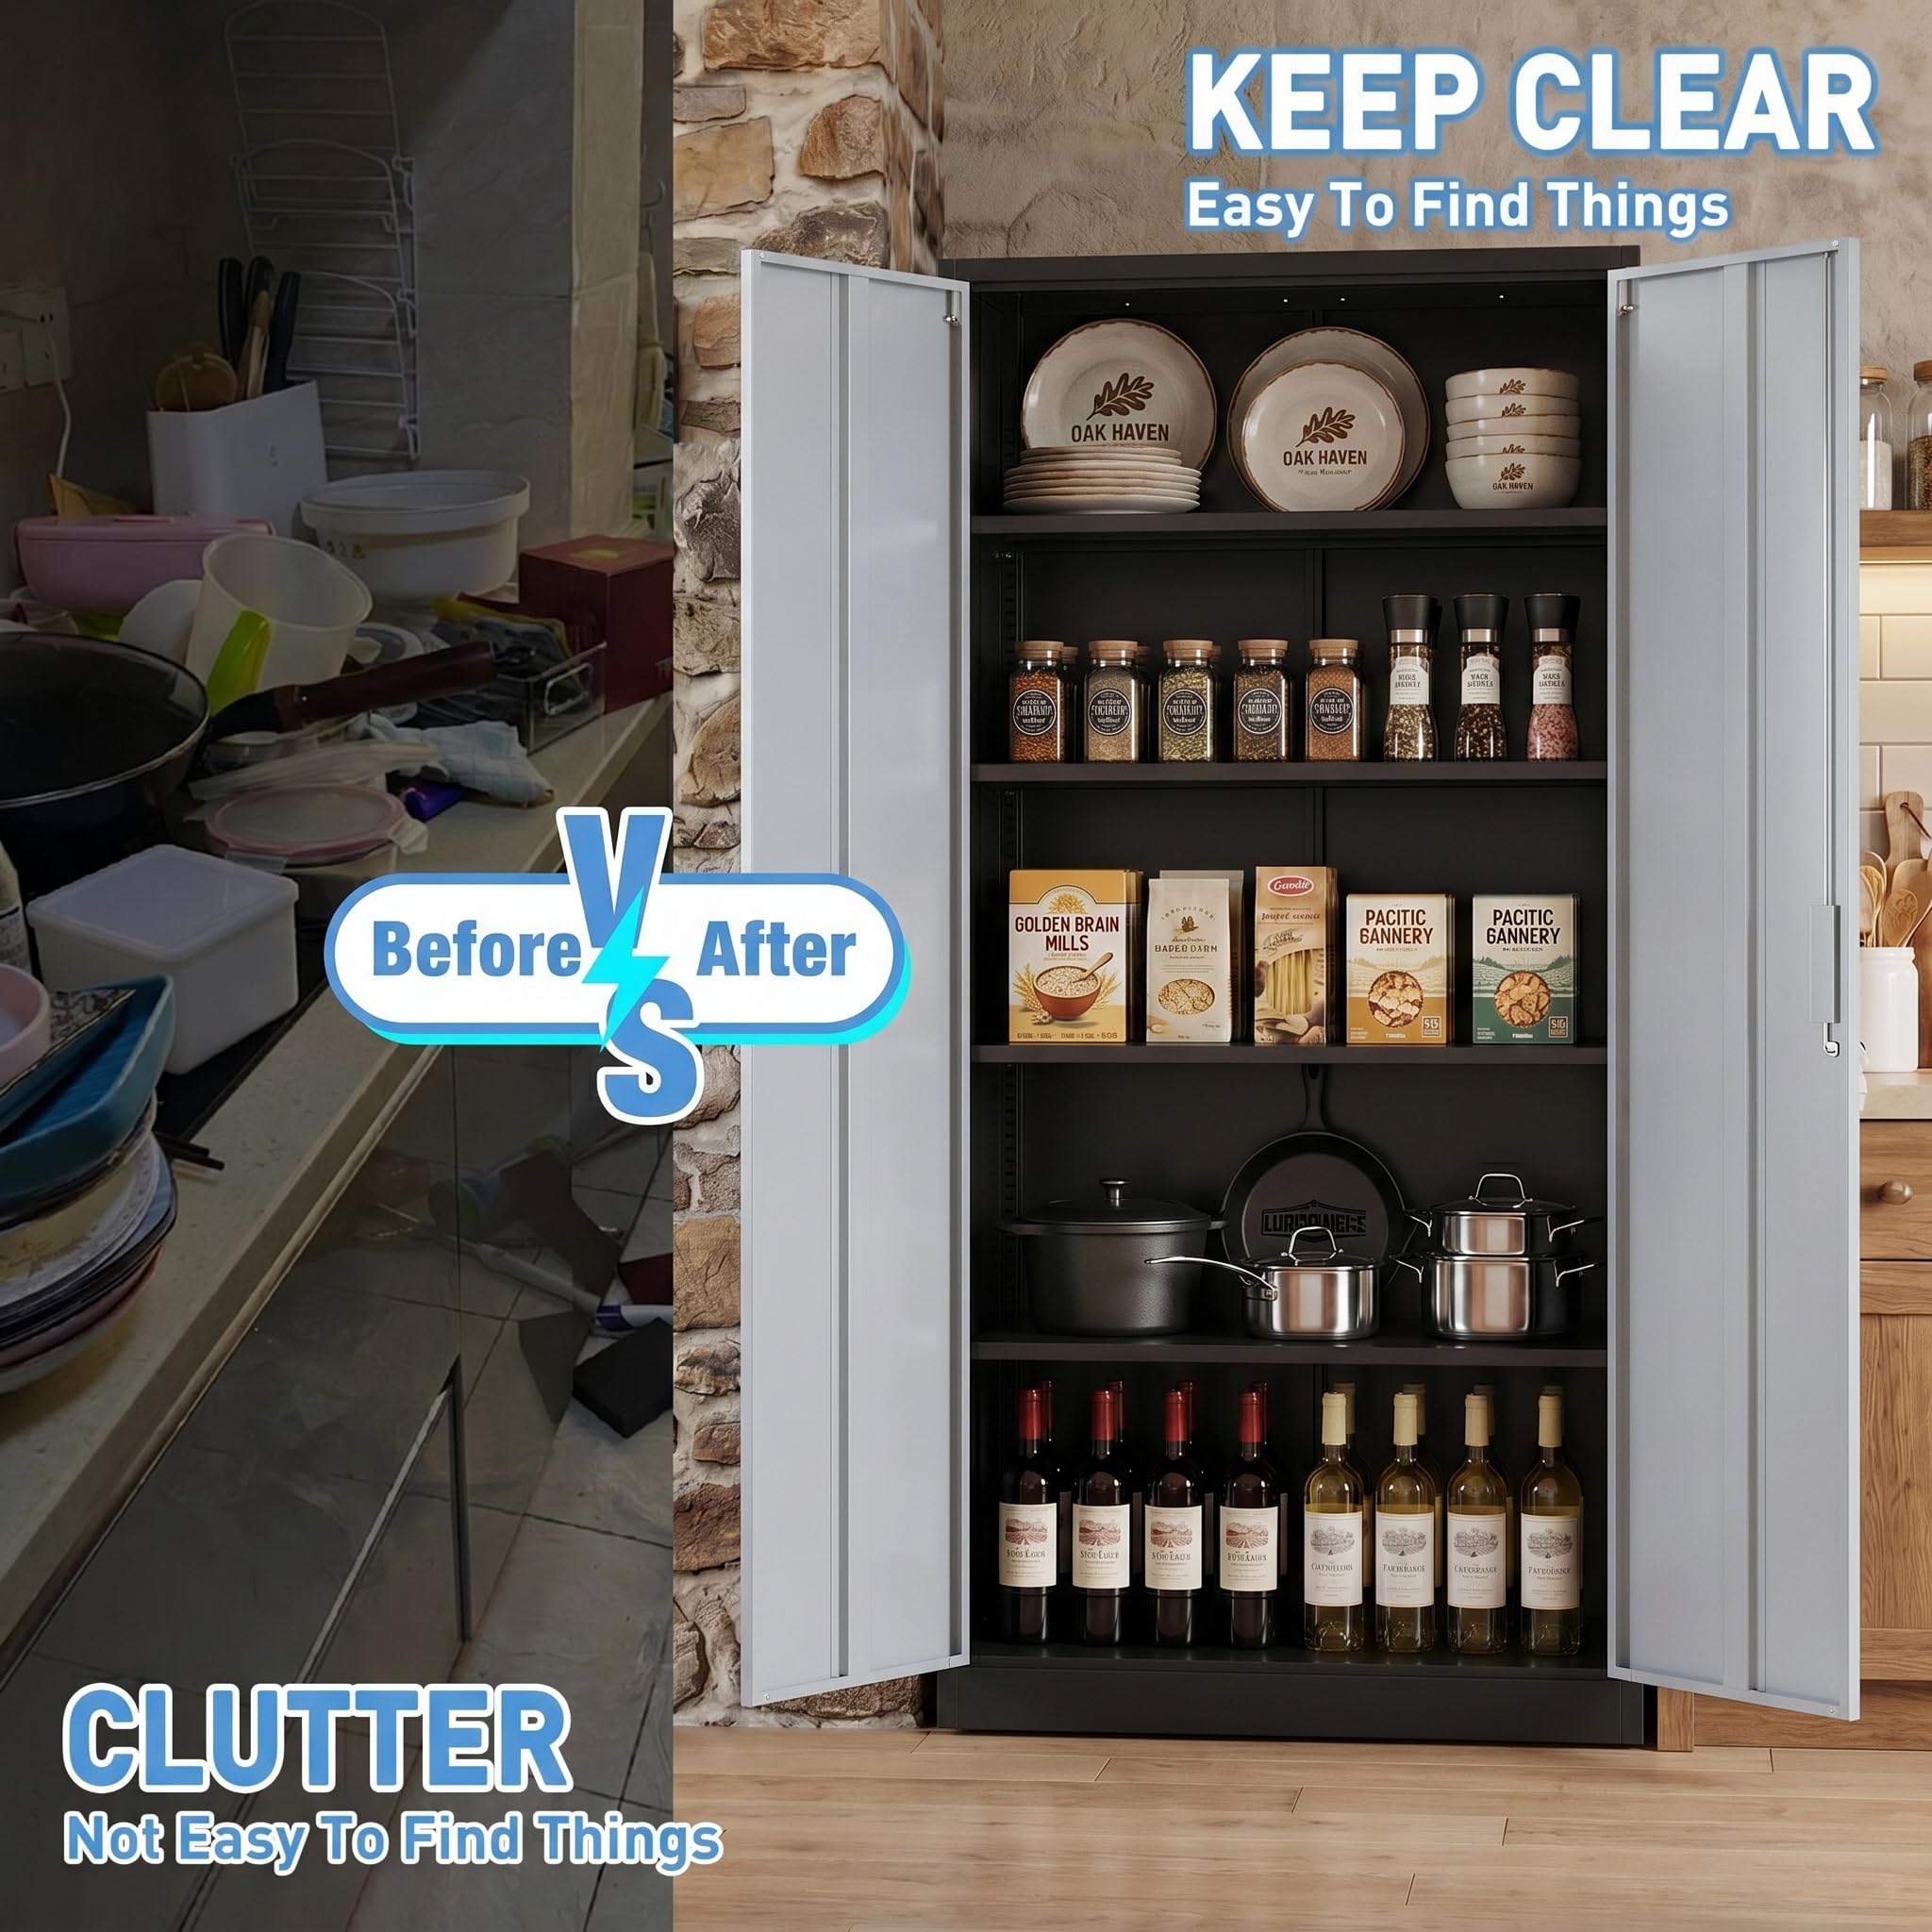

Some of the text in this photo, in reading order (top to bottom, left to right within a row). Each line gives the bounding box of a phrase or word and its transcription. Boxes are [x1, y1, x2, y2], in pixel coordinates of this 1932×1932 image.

[1072, 423, 1169, 442] OAK HAVEN
[1283, 449, 1367, 466] OAK HAVEN
[1014, 916, 1120, 933] GOLDEN BRAIN
[1365, 908, 1426, 926] PACITIC
[1492, 908, 1555, 926] PACITIC
[1045, 935, 1090, 952] MILLS
